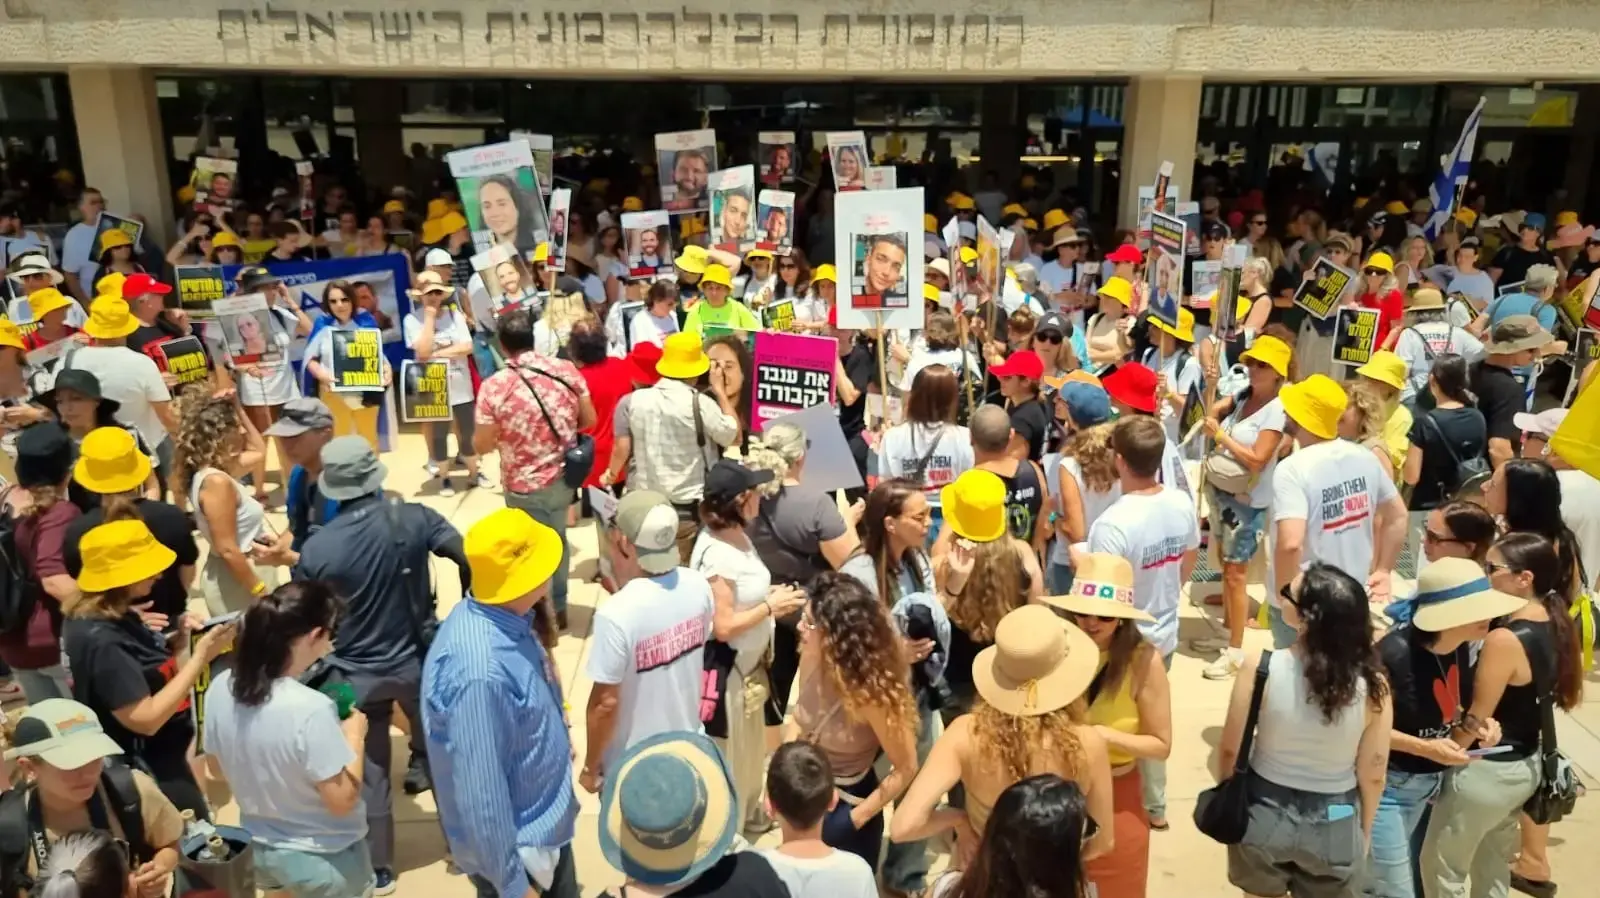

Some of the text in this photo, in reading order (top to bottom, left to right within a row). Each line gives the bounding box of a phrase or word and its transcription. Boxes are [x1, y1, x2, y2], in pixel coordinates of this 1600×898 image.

[217, 3, 1024, 46] התזמורת הפילהרמונית הישראלית
[758, 365, 831, 389] את ענבר
[757, 382, 831, 410] לקבורה
[1322, 476, 1367, 503] BRING THEM
[1322, 501, 1343, 520] HOME
